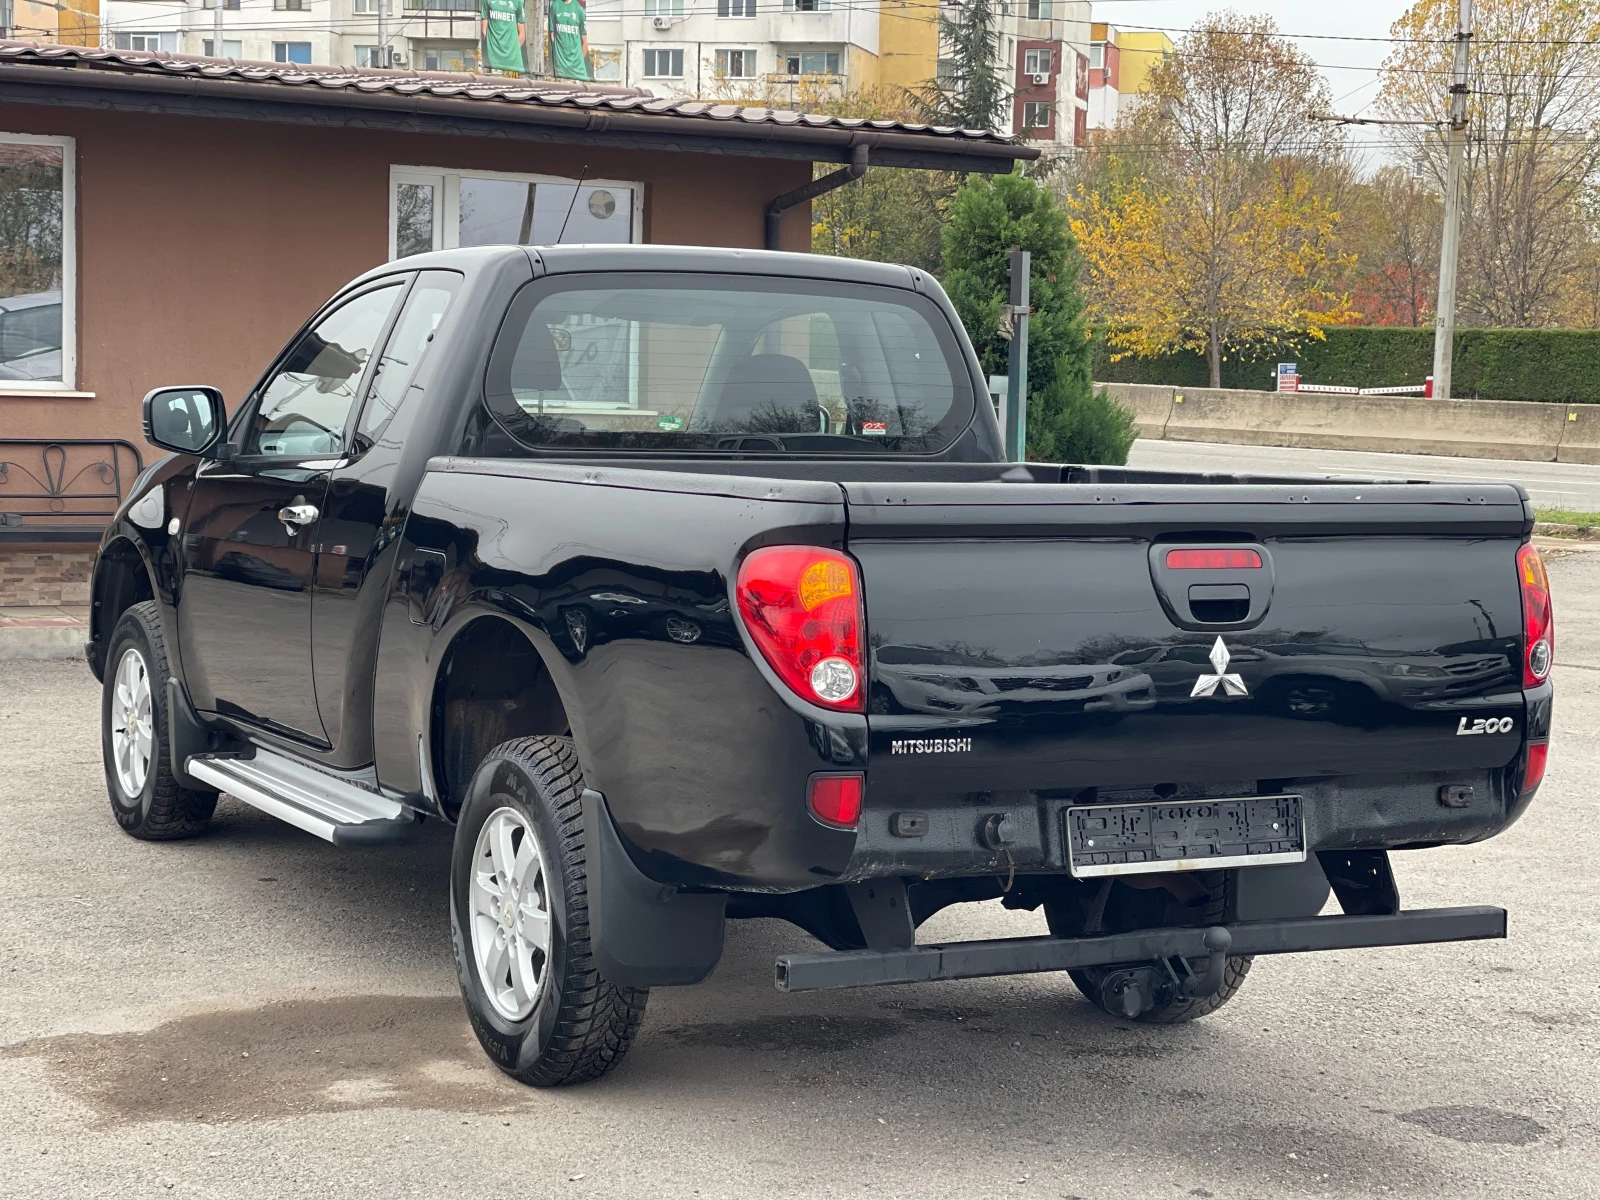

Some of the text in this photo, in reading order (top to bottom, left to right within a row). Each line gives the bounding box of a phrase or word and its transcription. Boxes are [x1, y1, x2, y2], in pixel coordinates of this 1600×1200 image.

[490, 9, 515, 22] WINBET
[555, 23, 579, 35] WINBET
[1456, 716, 1514, 736] L200
[891, 737, 972, 754] MITSUBISHI
